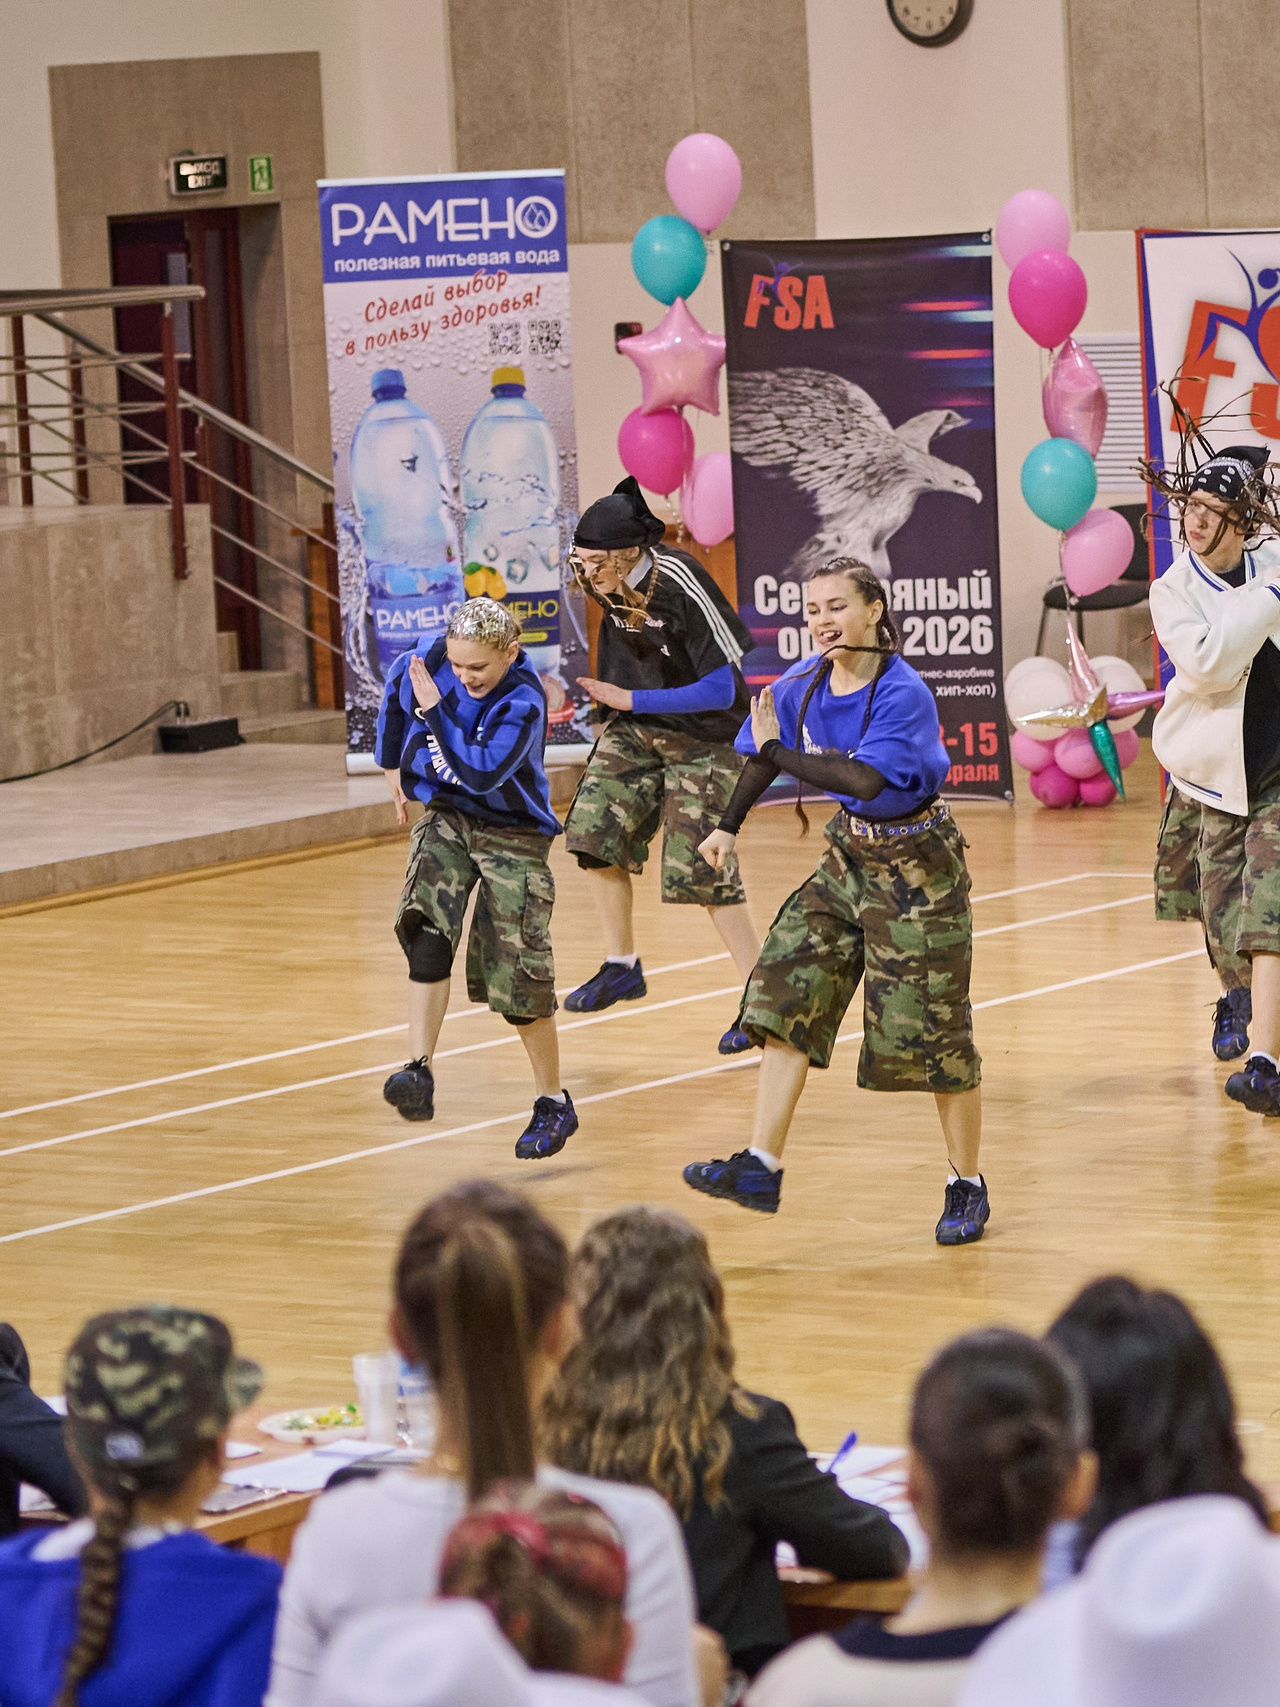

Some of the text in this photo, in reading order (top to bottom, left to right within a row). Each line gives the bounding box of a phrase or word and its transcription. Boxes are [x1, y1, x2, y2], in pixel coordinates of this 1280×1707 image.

[334, 249, 561, 273] полезная питьевая вода
[364, 269, 508, 323] Сделай выбор
[743, 274, 835, 330] FSA
[345, 285, 541, 356] в пользу здоровья!
[753, 569, 993, 621] Сеяный
[902, 614, 994, 656] 2026
[917, 667, 995, 680] тнес-аэробике
[935, 681, 997, 698] хип-хоп)
[939, 721, 998, 757] -15
